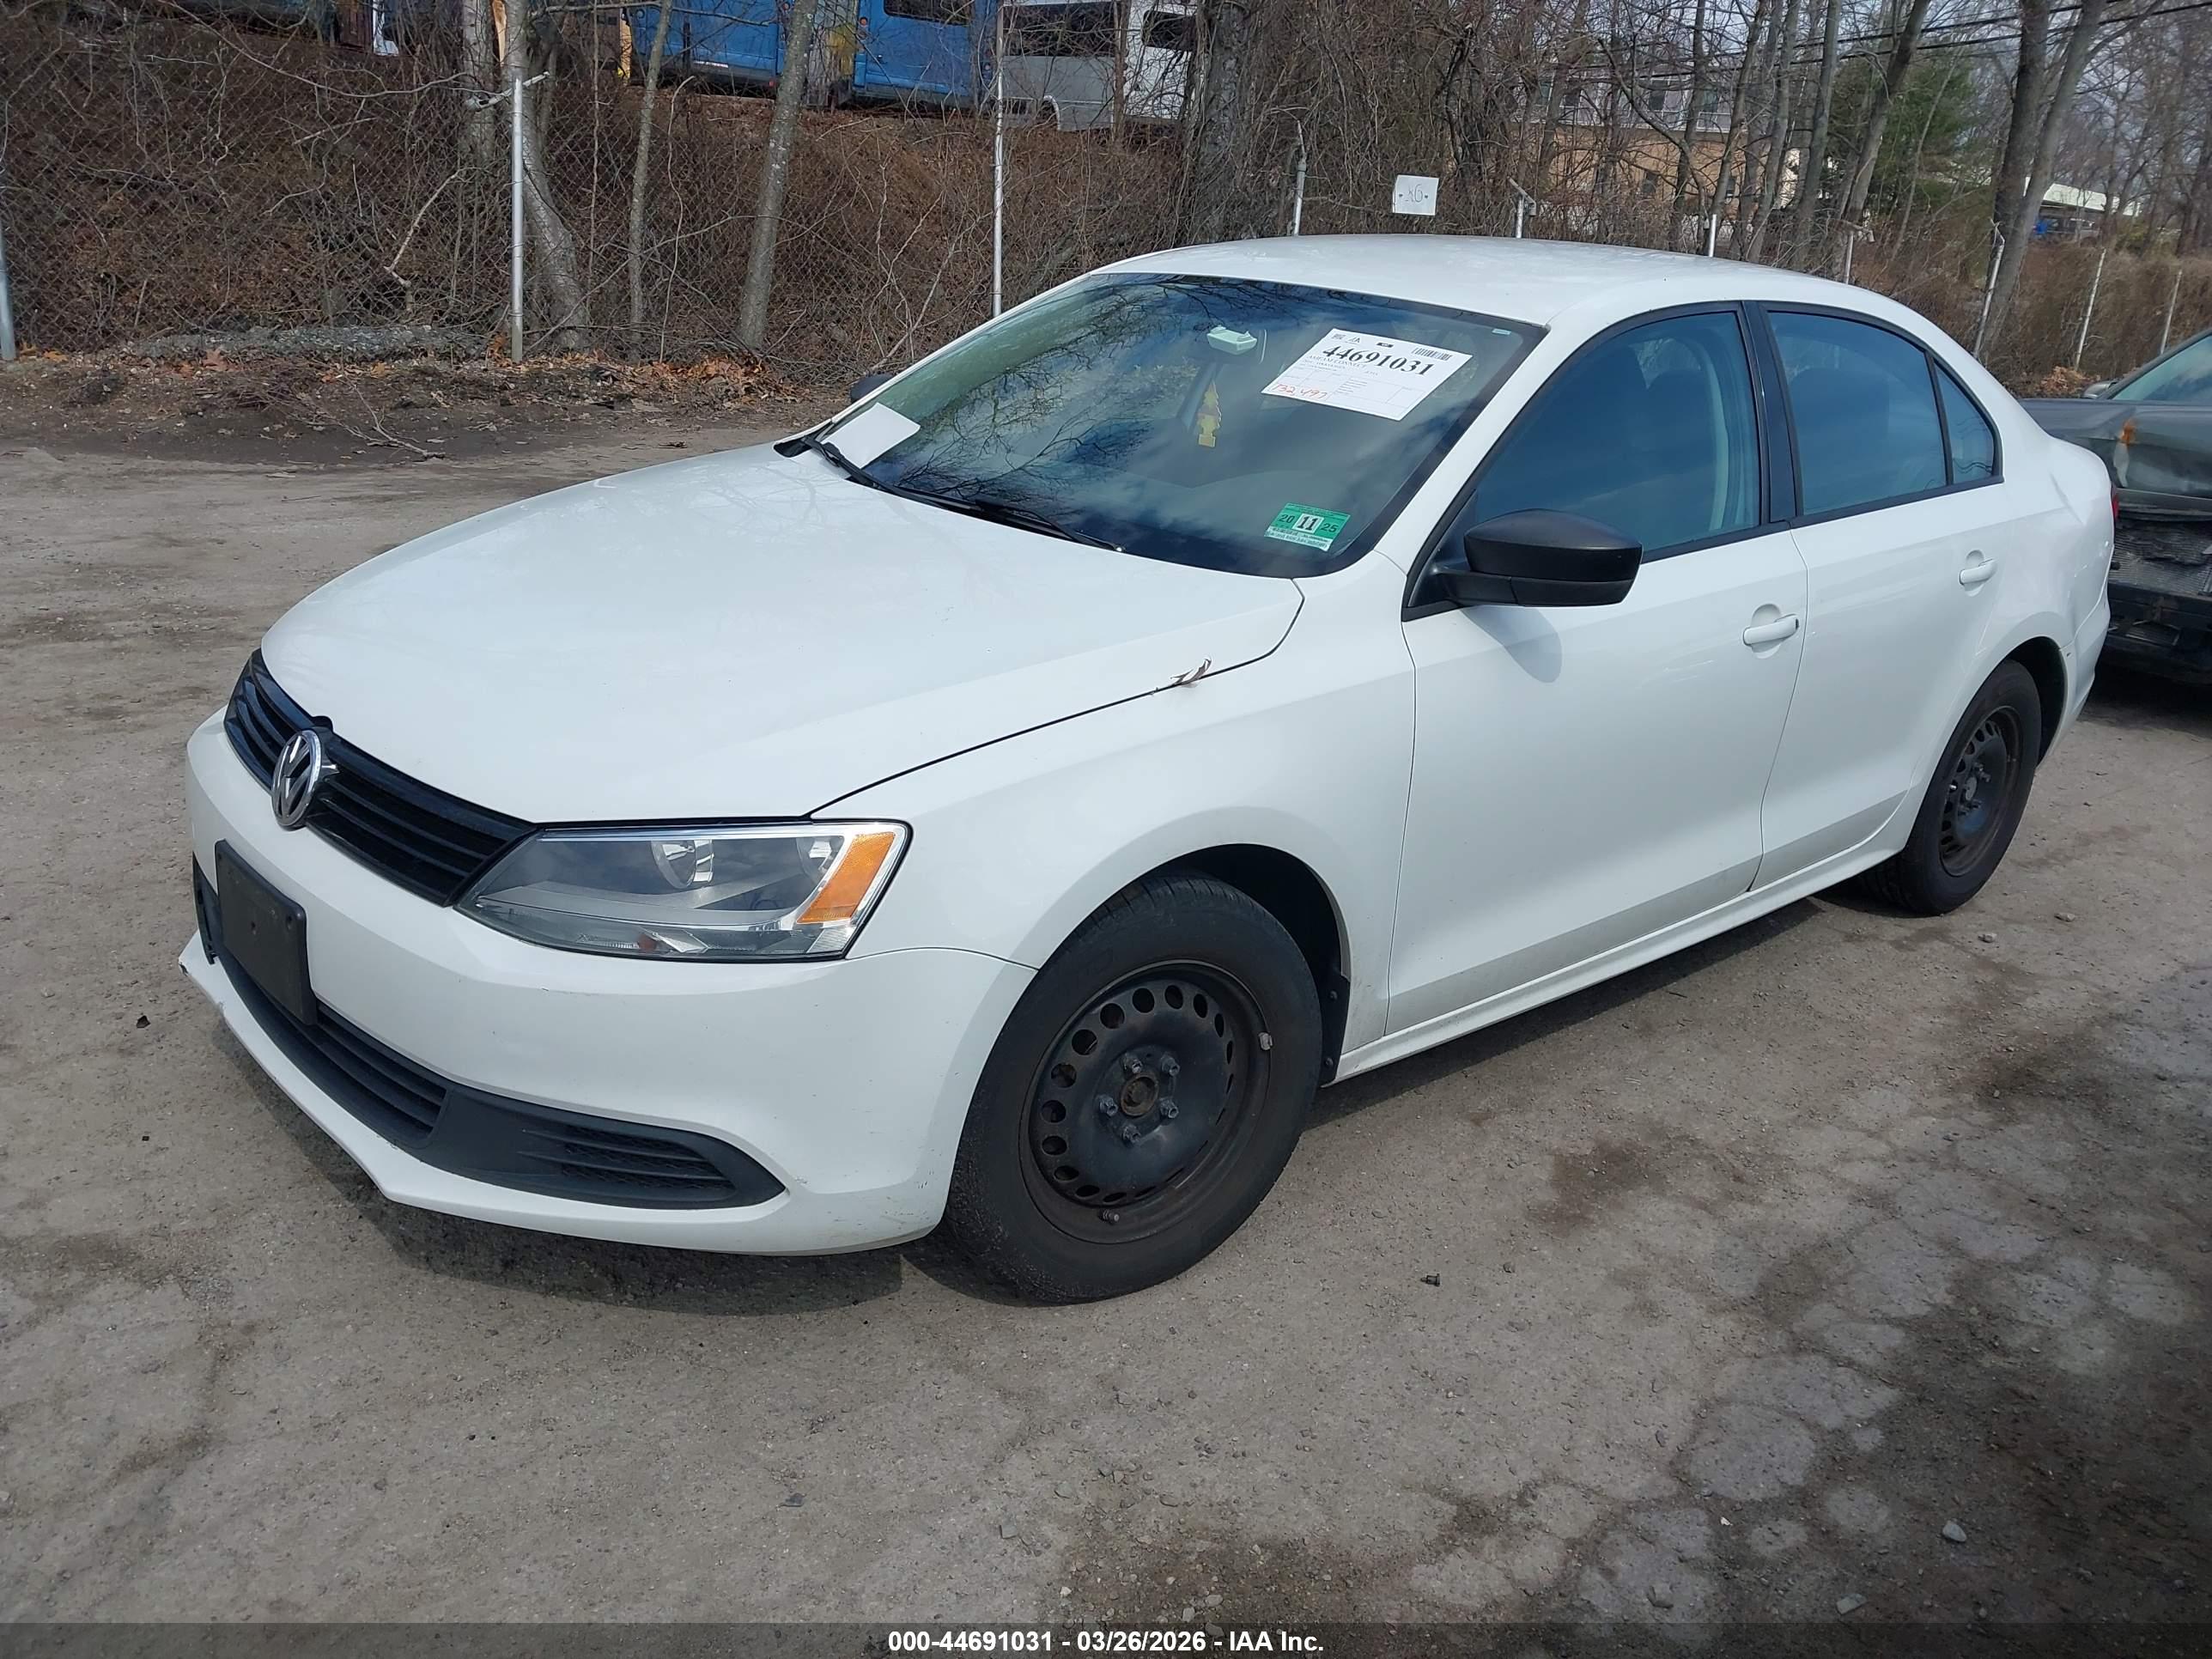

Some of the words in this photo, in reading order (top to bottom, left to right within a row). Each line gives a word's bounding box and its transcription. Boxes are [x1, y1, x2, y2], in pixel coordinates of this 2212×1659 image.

[1322, 345, 1435, 376] 44691031
[1279, 514, 1295, 524] 20
[1297, 516, 1317, 531] 11
[1321, 523, 1340, 533] 25
